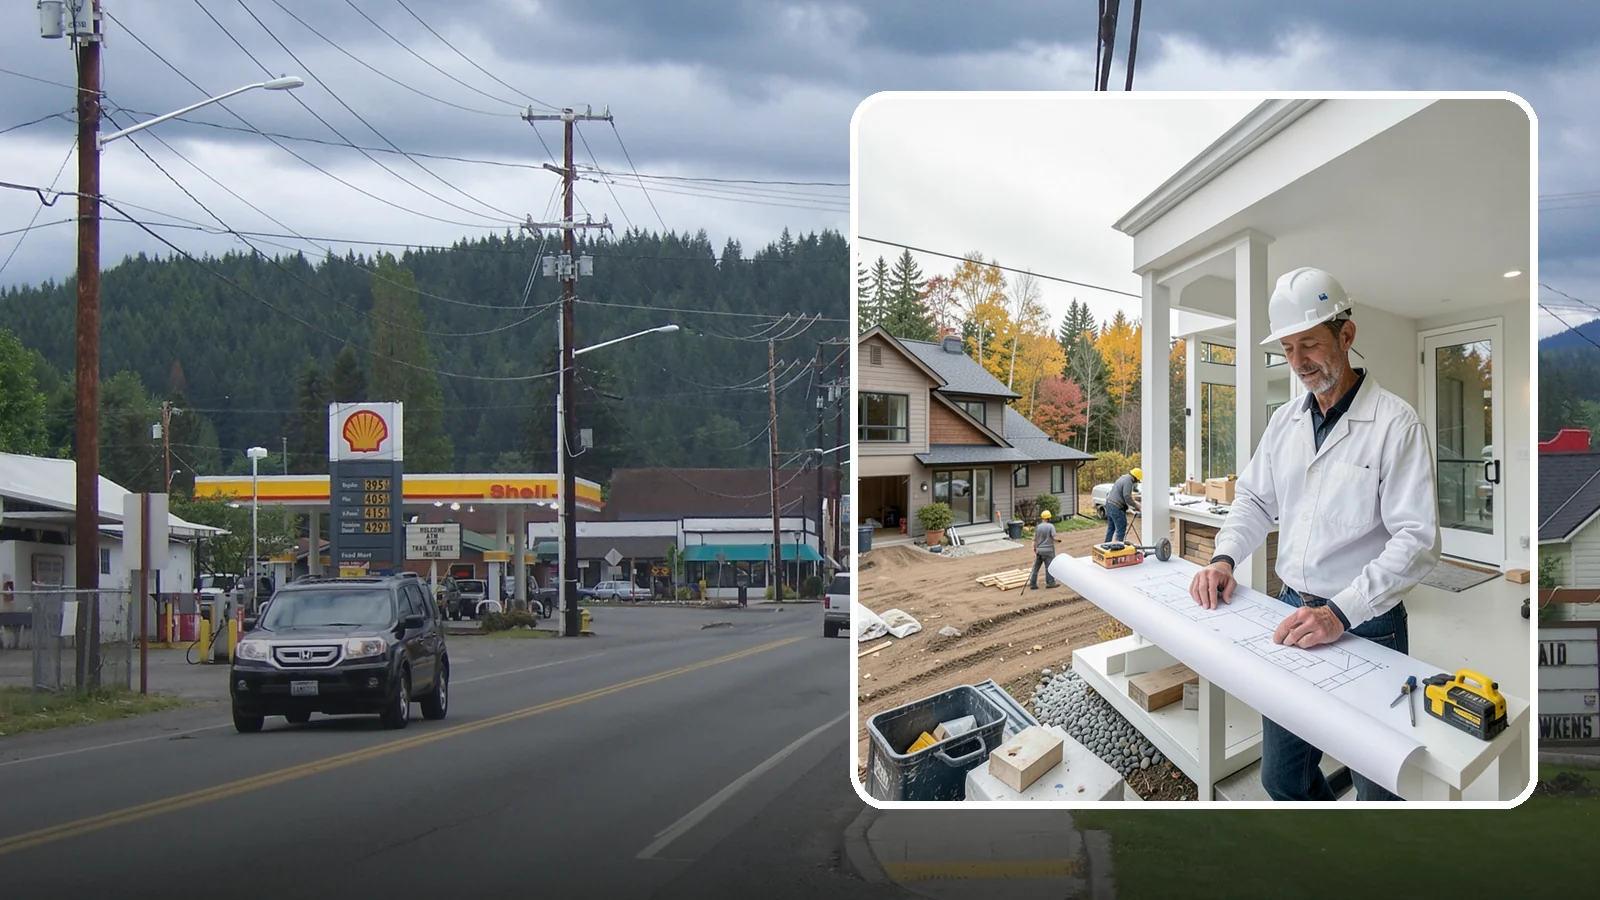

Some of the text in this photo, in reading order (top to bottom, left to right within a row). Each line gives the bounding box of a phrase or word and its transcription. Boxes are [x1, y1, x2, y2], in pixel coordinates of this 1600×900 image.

[366, 480, 383, 490] 395
[490, 484, 547, 499] Shell
[366, 494, 383, 504] 405
[366, 508, 383, 518] 415
[366, 522, 383, 532] 429
